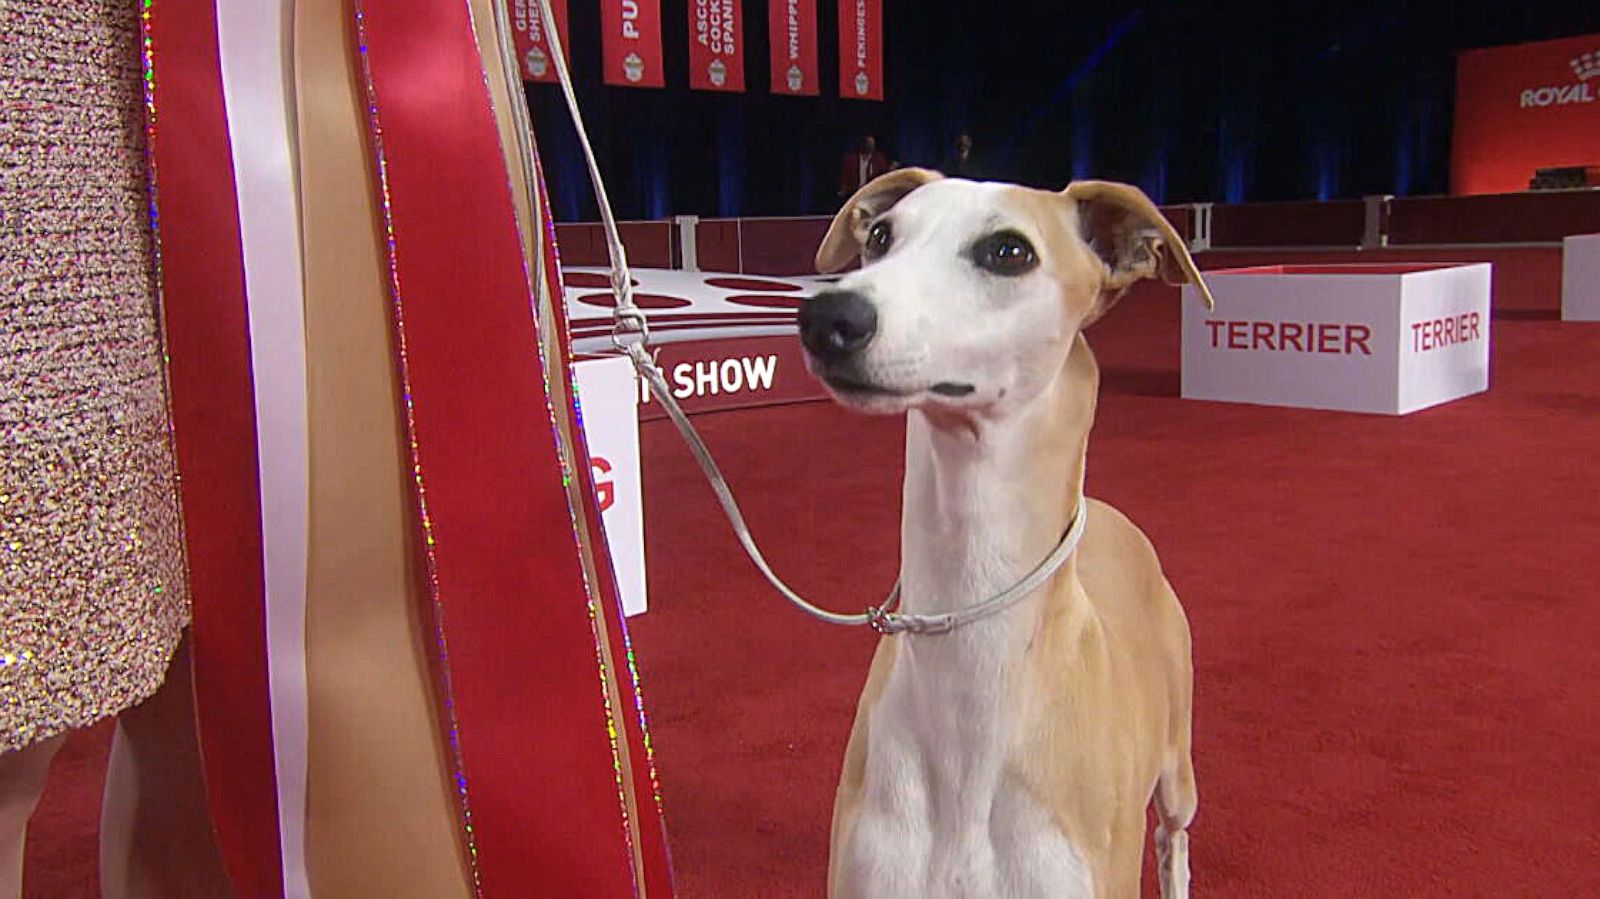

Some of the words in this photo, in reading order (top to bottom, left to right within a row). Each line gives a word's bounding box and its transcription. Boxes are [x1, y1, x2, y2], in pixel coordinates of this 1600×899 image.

[622, 0, 639, 40] PU
[709, 0, 722, 54] COCK
[1519, 82, 1596, 109] ROYAL
[1204, 319, 1373, 355] TERRIER
[1411, 311, 1480, 354] TERRIER
[672, 353, 778, 399] SHOW
